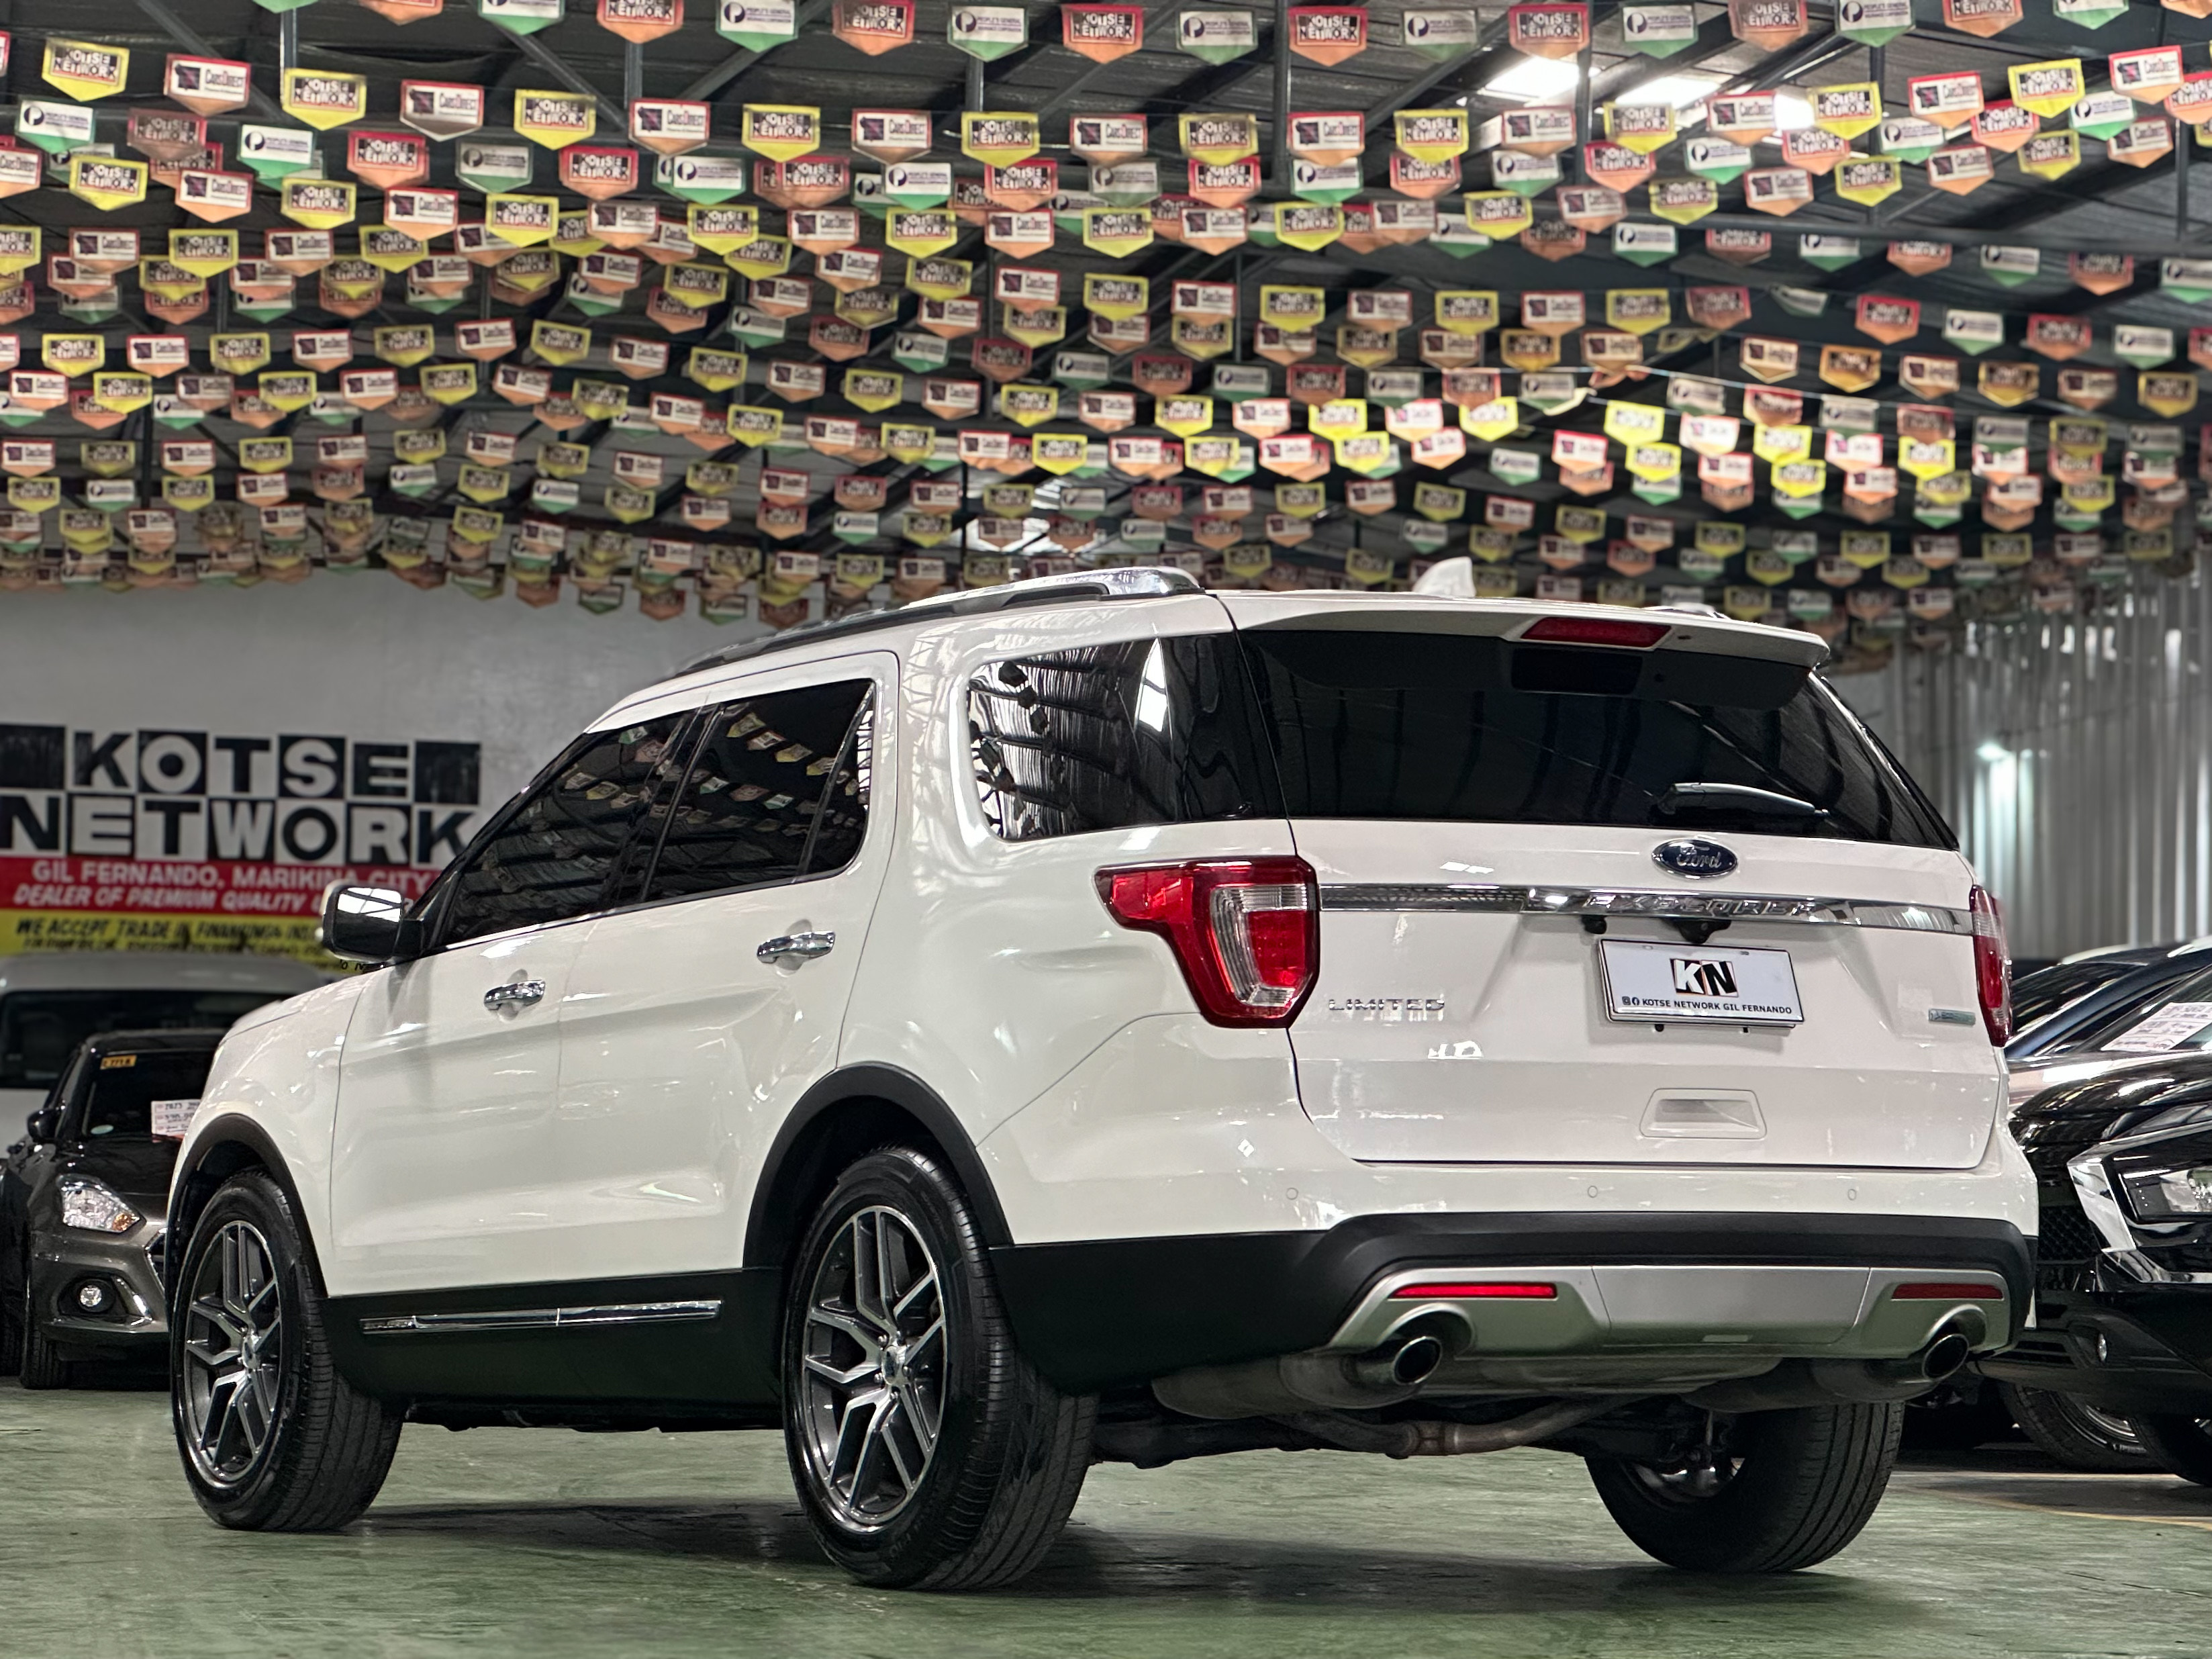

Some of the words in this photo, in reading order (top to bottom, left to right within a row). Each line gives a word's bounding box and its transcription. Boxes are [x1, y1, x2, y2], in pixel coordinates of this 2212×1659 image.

[74, 732, 408, 798] KOTSE
[0, 795, 474, 864] NETWORK
[1676, 845, 1722, 868] Ford
[32, 860, 74, 883] GIL
[81, 861, 225, 888] FERNANDO,
[232, 867, 358, 890] MARIKINA
[369, 869, 430, 894] CITY
[13, 884, 92, 907] DEALER
[94, 886, 125, 907] OF
[126, 887, 218, 909] PREMIUM
[222, 890, 309, 912] QUALITY
[46, 918, 111, 936] ACCEPT
[1676, 959, 1737, 996] KN
[1329, 998, 1445, 1010] LIMITED
[1642, 998, 1671, 1008] KOTSE
[1674, 1000, 1721, 1010] NETWORK
[1723, 1002, 1739, 1012] GIL
[1743, 1004, 1792, 1014] FERNANDO
